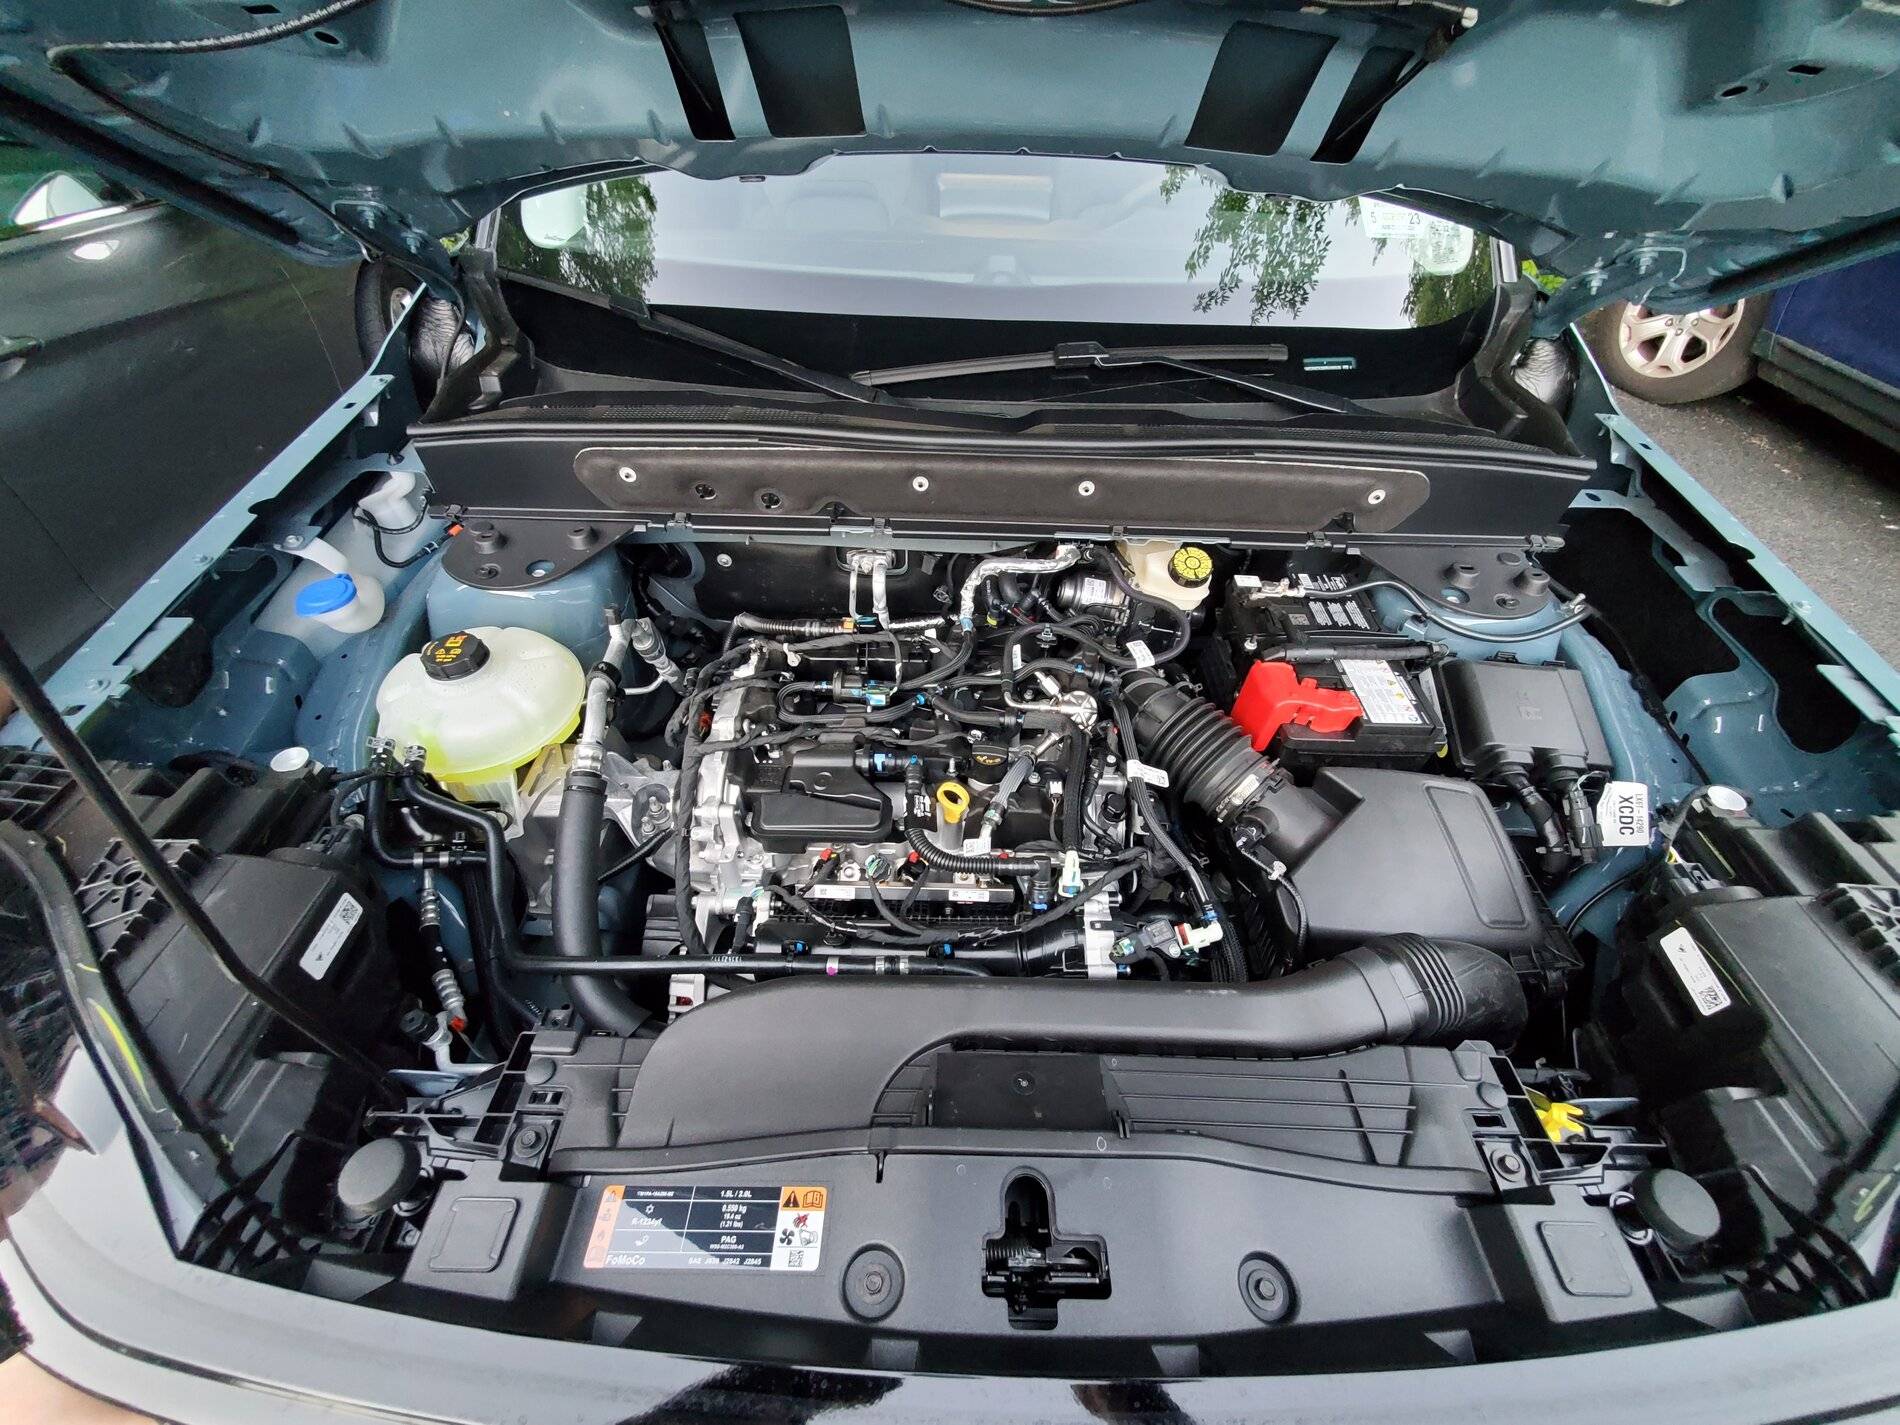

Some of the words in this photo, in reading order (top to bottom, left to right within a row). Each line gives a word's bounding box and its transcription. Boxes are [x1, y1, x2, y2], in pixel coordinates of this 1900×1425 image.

[1408, 212, 1421, 225] 23
[1618, 794, 1635, 835] XCDC
[739, 1204, 747, 1214] kg
[721, 1235, 737, 1244] PAG
[605, 1254, 646, 1265] FoMoCo
